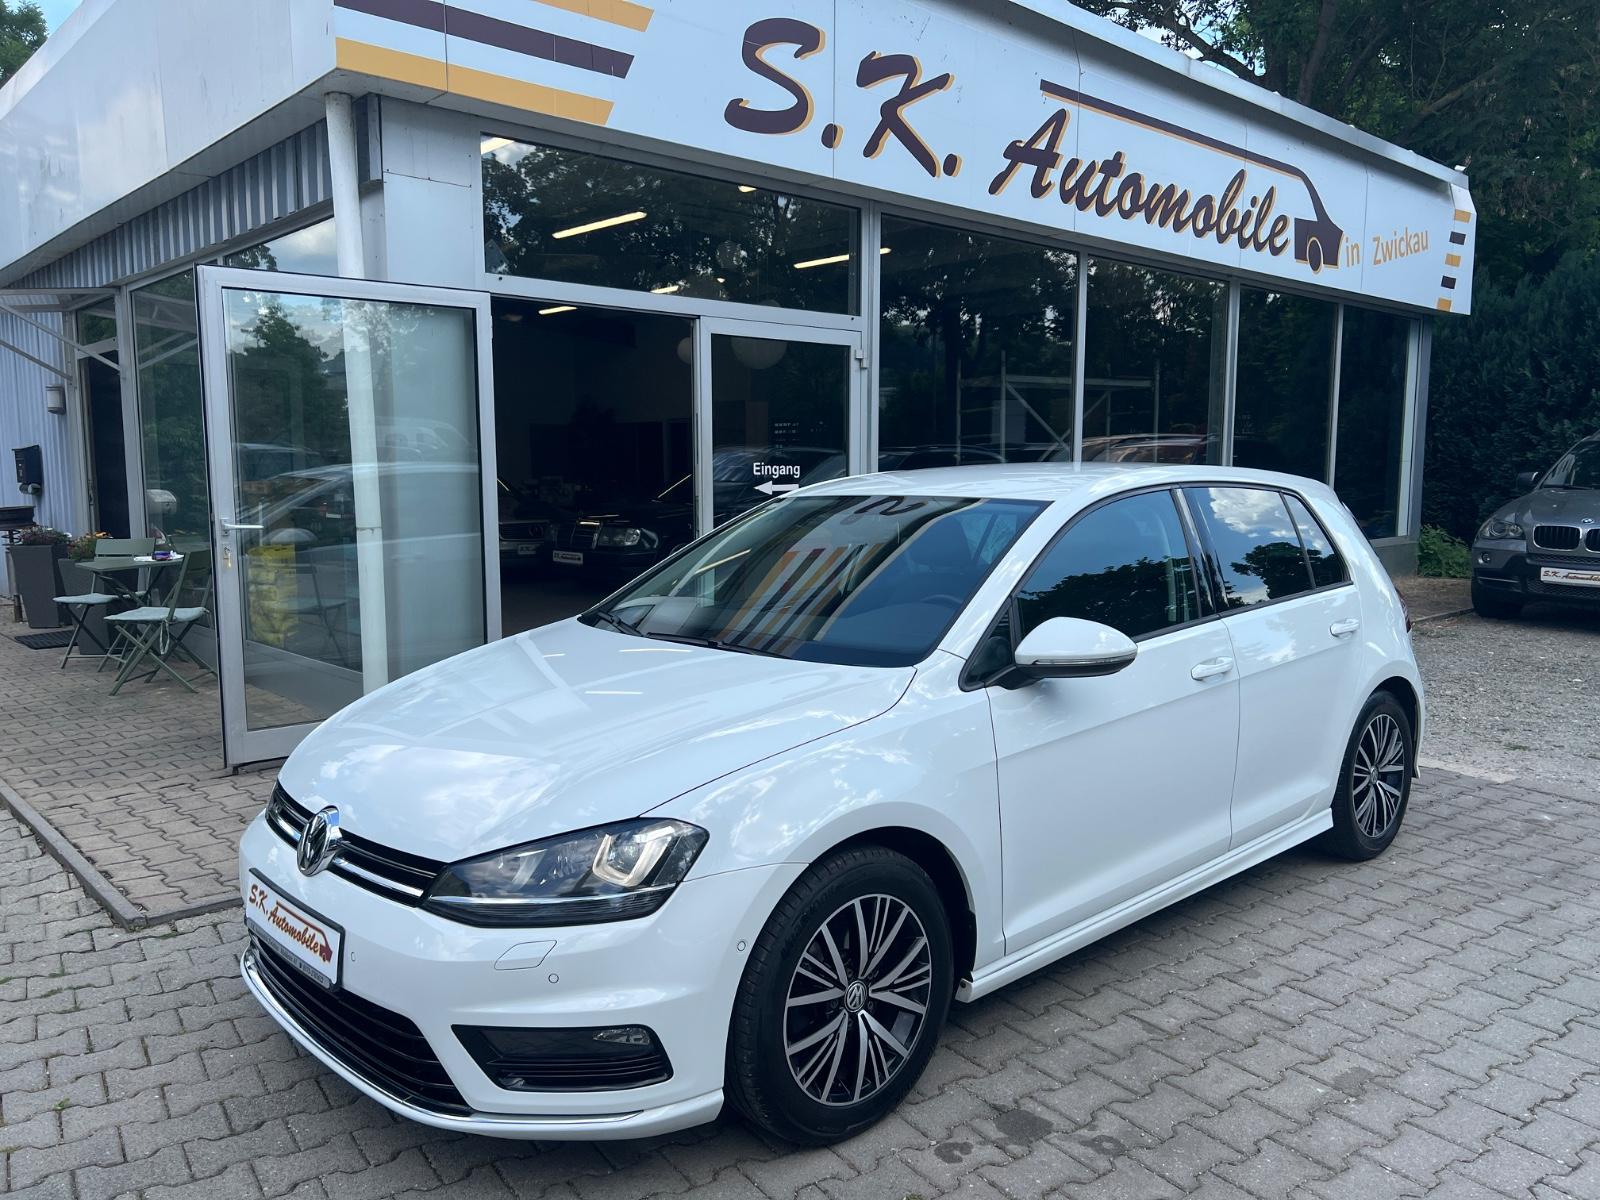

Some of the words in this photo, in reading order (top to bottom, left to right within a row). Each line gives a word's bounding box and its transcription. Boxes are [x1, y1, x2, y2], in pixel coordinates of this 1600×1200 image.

[724, 17, 962, 178] S.K.
[988, 108, 1291, 257] Automobile
[1346, 237, 1360, 267] in
[1373, 227, 1429, 265] Zwickau
[752, 462, 801, 479] Eingang
[249, 884, 269, 915] S.K.
[267, 905, 319, 954] Automobile
